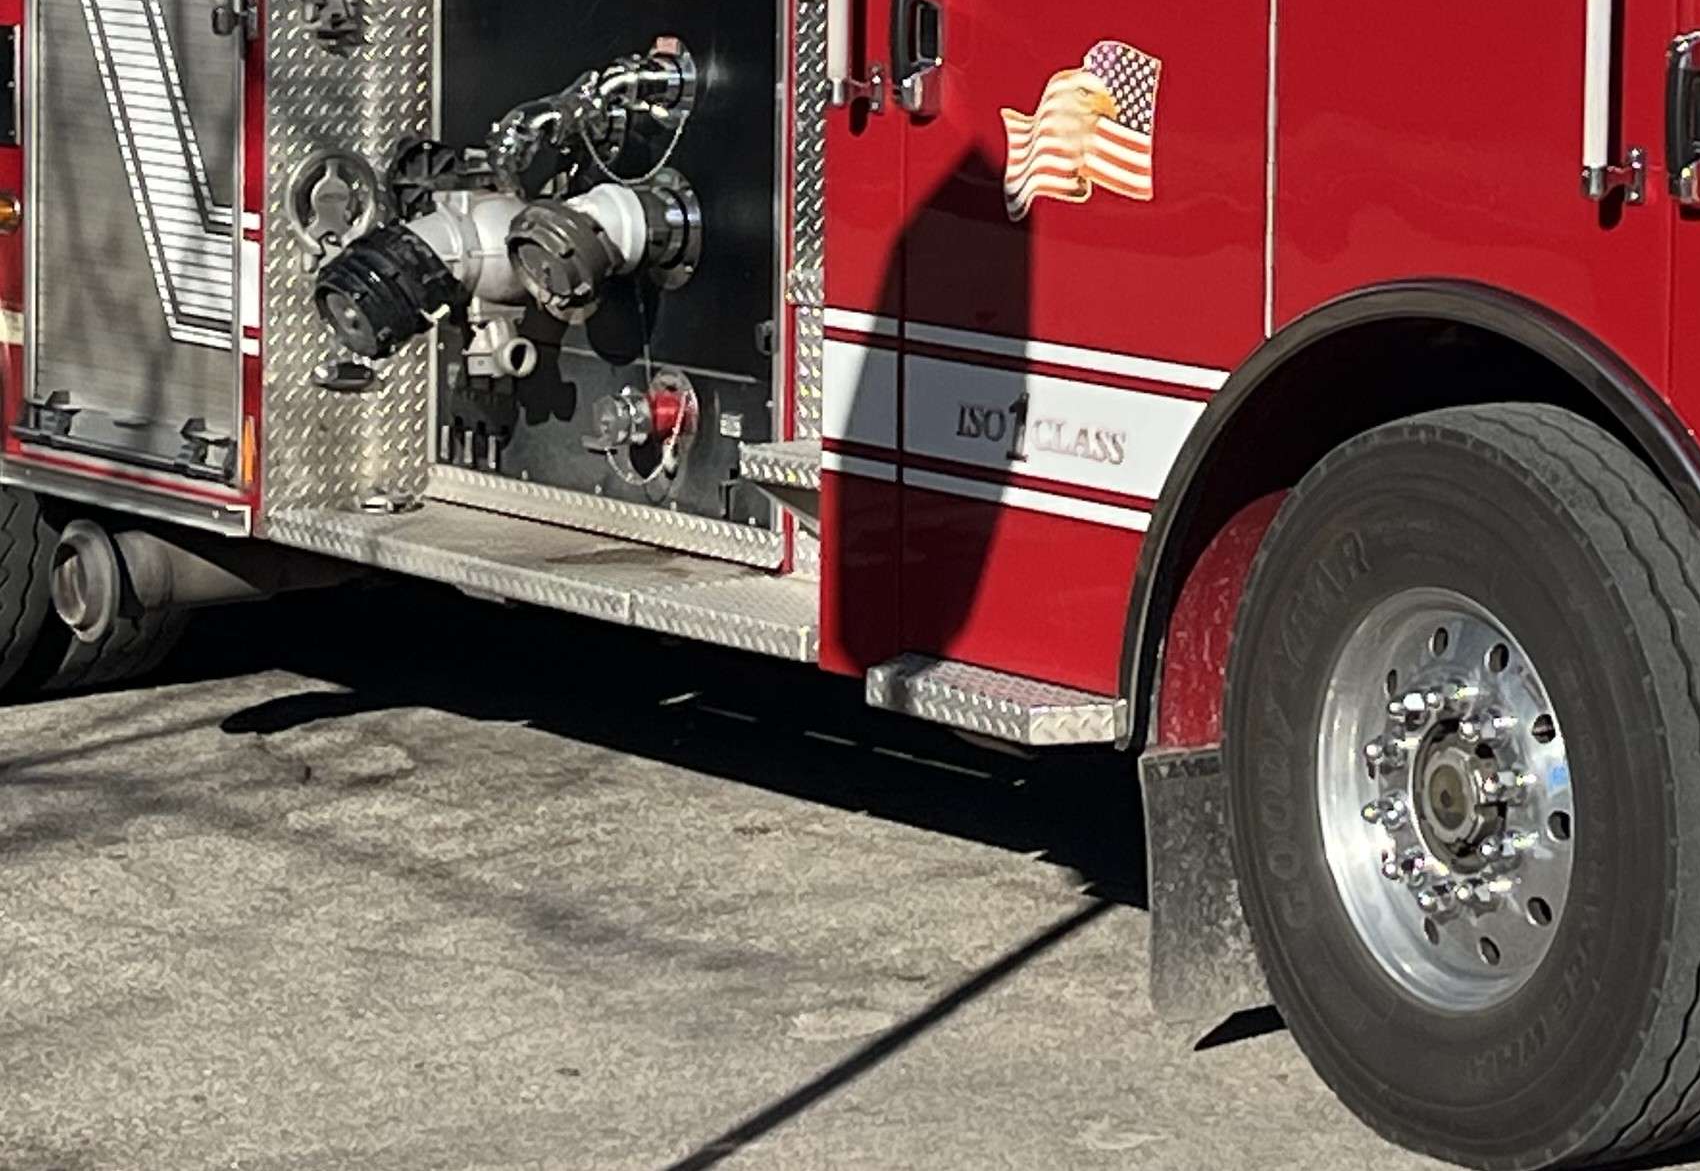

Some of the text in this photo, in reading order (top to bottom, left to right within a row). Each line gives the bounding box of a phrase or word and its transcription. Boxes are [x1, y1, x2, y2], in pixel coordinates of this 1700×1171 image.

[956, 392, 1126, 465] ISO 1 CLASS
